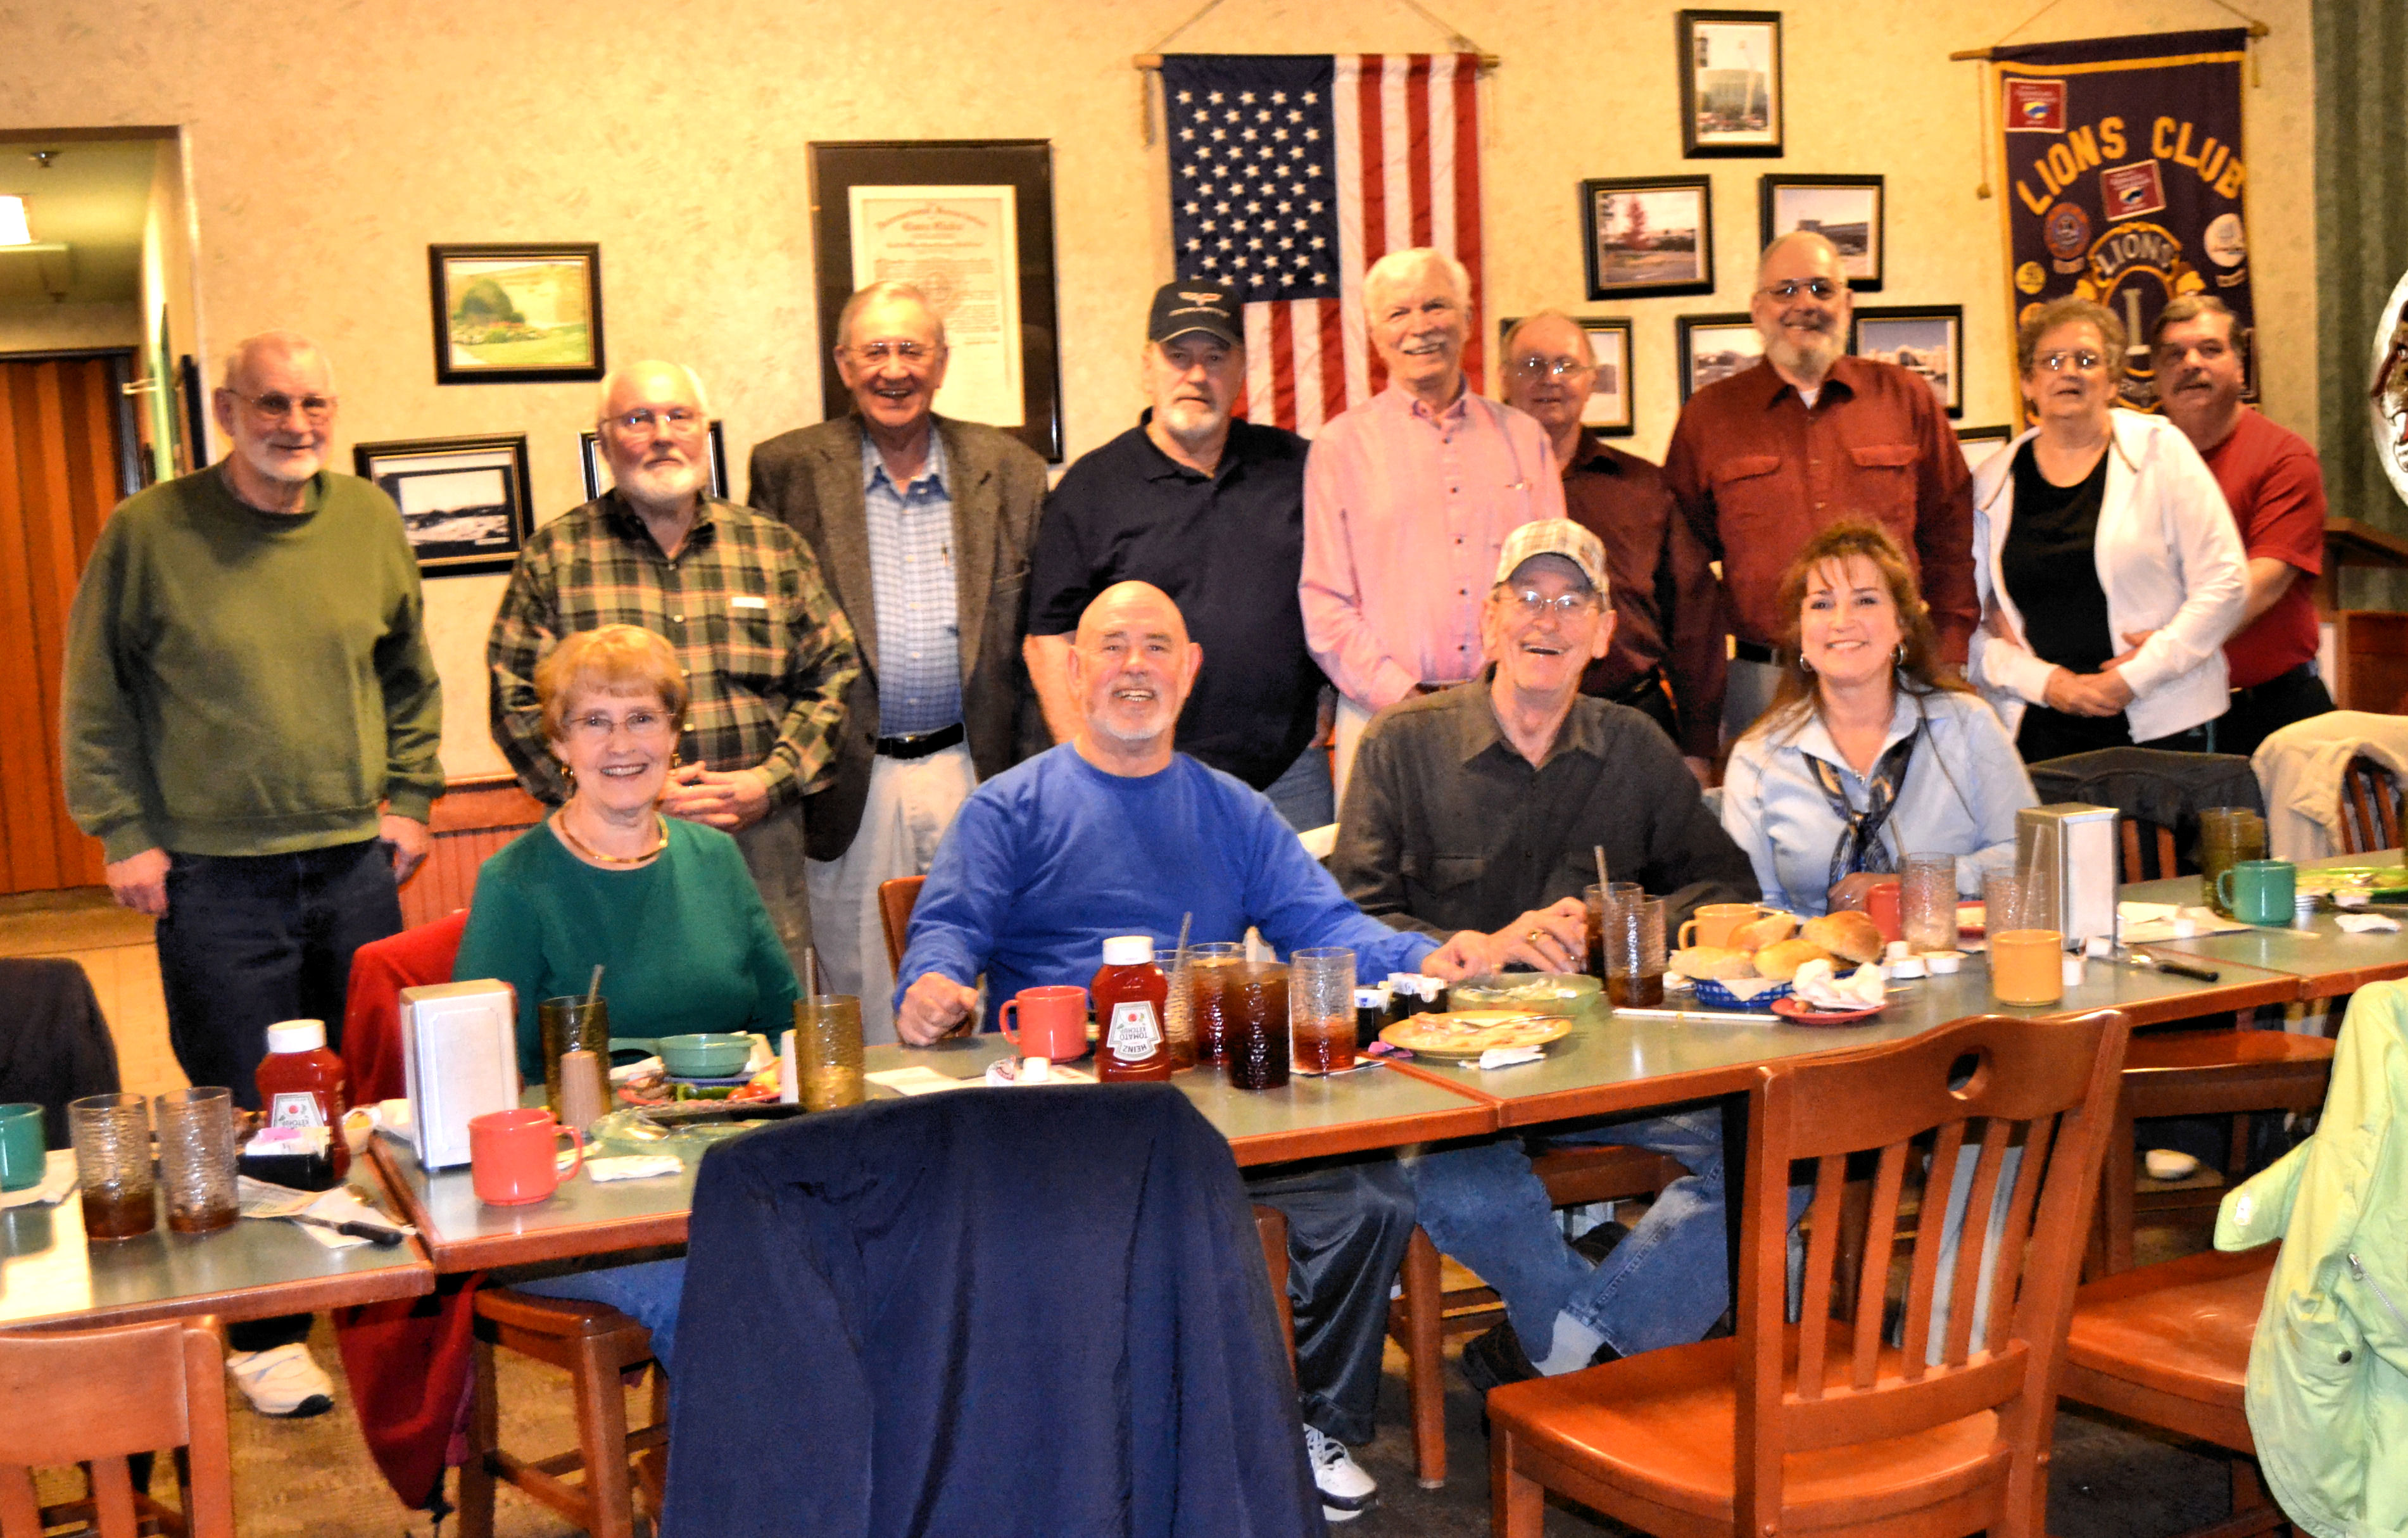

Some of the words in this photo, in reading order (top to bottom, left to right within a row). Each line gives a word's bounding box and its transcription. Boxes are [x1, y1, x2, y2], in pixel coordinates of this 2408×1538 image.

[2015, 116, 2128, 217] LIONS
[2152, 116, 2245, 200] CLUB
[2095, 233, 2176, 276] LIONS
[1119, 1032, 1148, 1041] TOMATO
[1122, 1044, 1147, 1053] HEINZ
